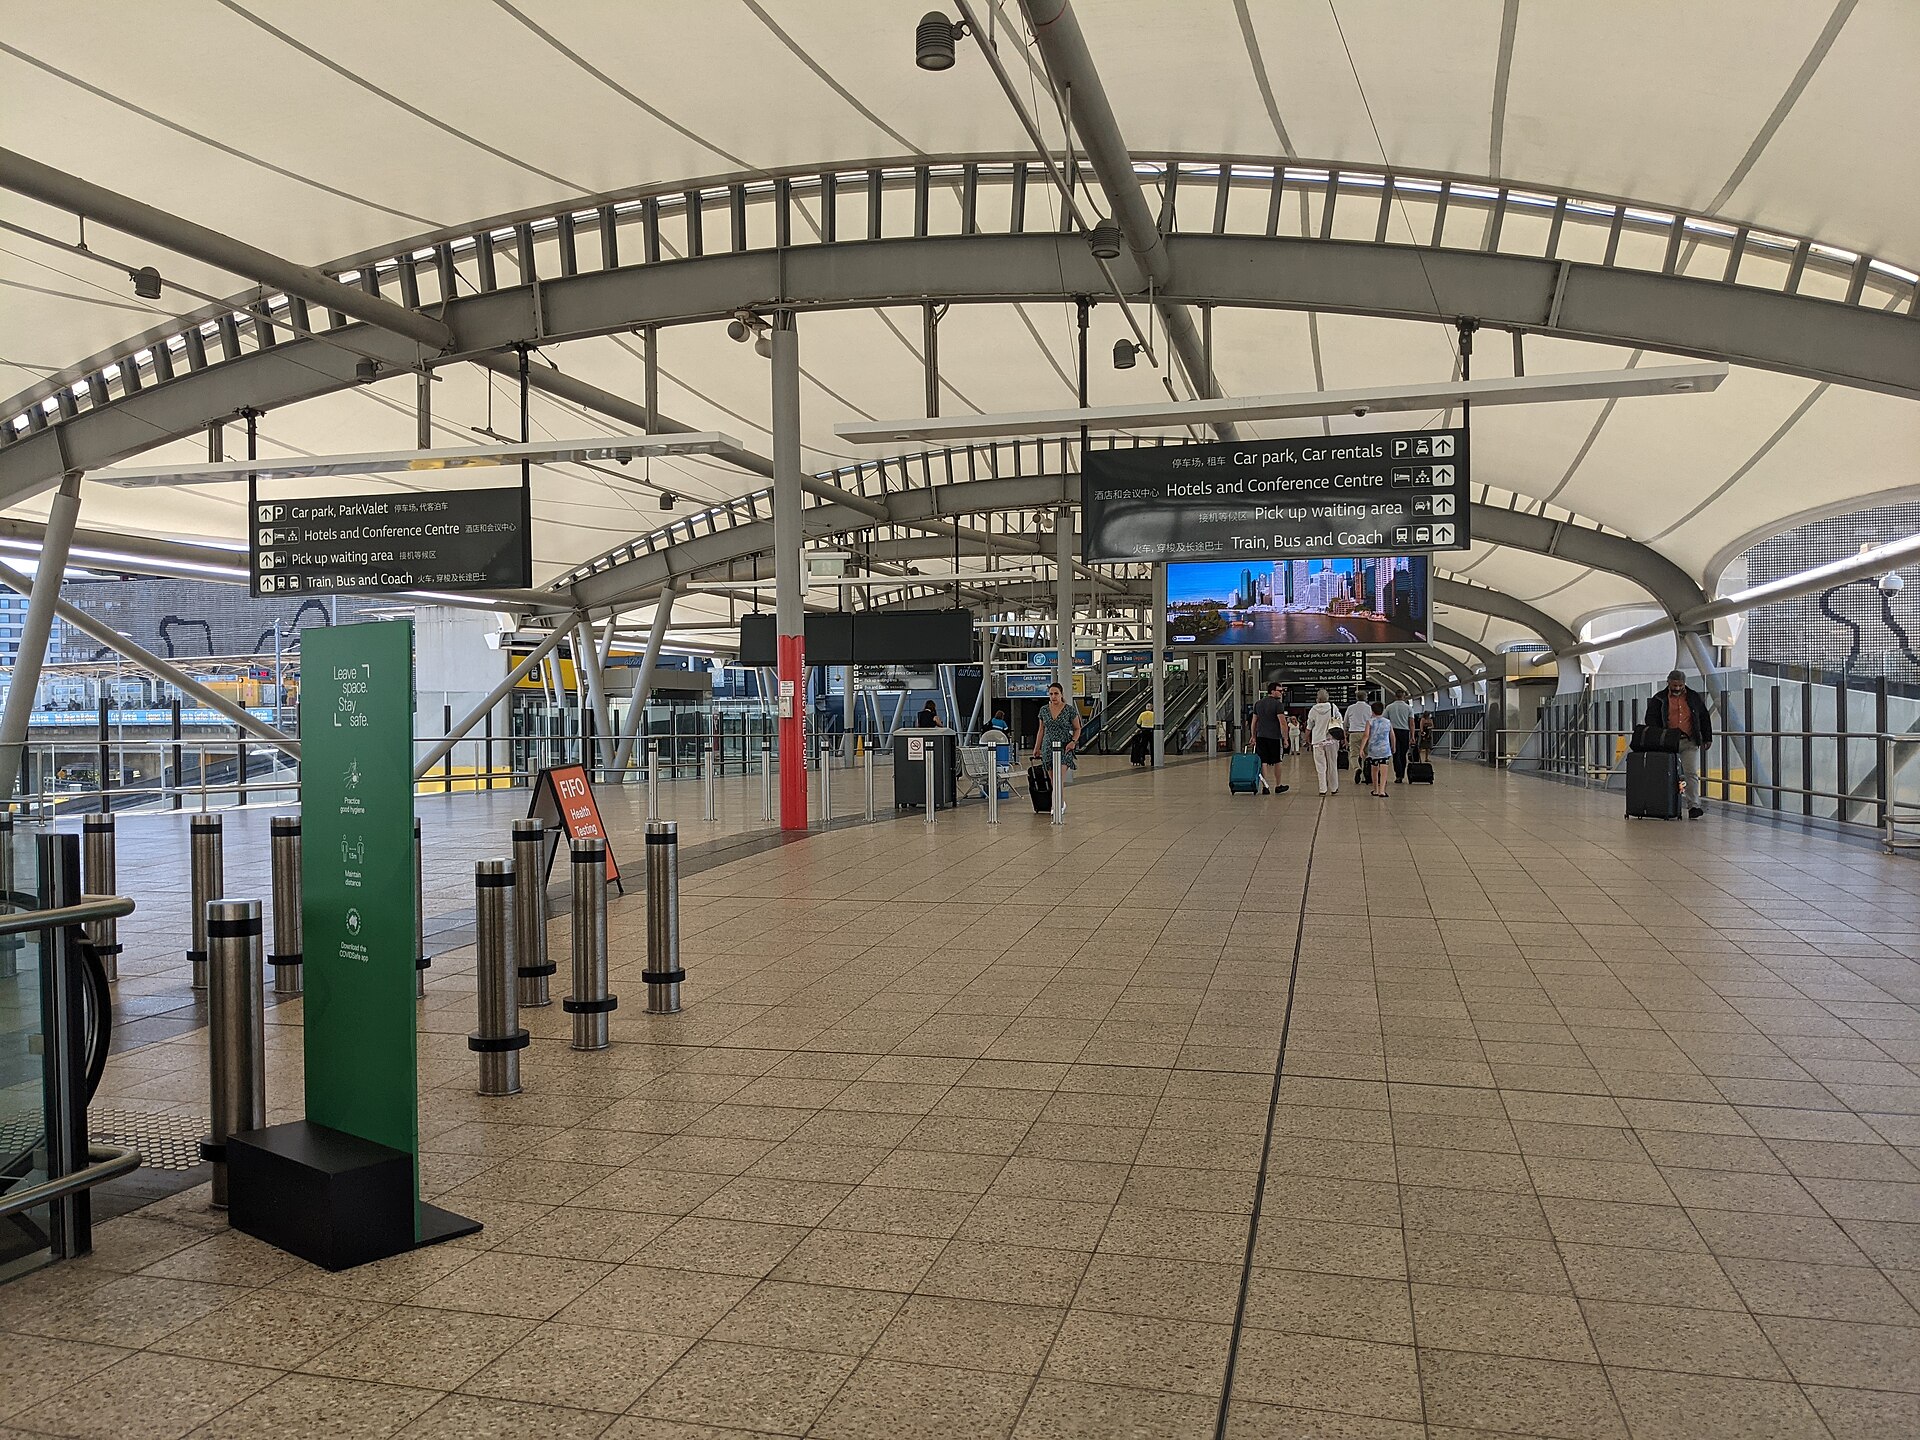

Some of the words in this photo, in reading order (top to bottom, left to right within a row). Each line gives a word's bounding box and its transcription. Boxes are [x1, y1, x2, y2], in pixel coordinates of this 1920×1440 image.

[1234, 452, 1258, 465] Car
[1262, 448, 1298, 467] park,
[1302, 448, 1327, 460] Car
[1332, 444, 1383, 459] rentals
[1167, 481, 1212, 497] Hotels
[1216, 478, 1243, 493] and
[1248, 476, 1329, 491] Conference
[1334, 474, 1383, 488] Centre
[292, 507, 308, 518] Car
[312, 505, 336, 520] park,
[339, 502, 388, 515] ParkValet
[1255, 506, 1284, 520] Pick
[1288, 508, 1306, 522] up
[1312, 504, 1366, 519] waiting
[1371, 503, 1403, 515] area
[304, 528, 337, 540] Hotels
[340, 526, 359, 539] and
[362, 525, 421, 538] Conference
[424, 524, 460, 536] Centre
[1231, 536, 1269, 550] Train,
[1274, 535, 1300, 548] Bus
[1305, 532, 1333, 547] and
[1338, 530, 1383, 545] Coach
[292, 553, 312, 565] Pick
[315, 555, 327, 566] up
[330, 551, 367, 565] waiting
[371, 551, 393, 562] area
[307, 576, 334, 588] Train,
[336, 576, 355, 587] Bus
[359, 573, 378, 586] and
[380, 572, 412, 584] Coach
[334, 666, 357, 680] Leave
[343, 682, 368, 697] space.
[339, 697, 356, 714] Stay
[350, 713, 368, 726] safe.
[560, 778, 584, 799] FIFO
[570, 806, 591, 820] Health
[575, 823, 598, 836] Testing
[345, 870, 361, 878] Maintain
[341, 942, 359, 951] Download
[339, 950, 360, 960] COVIDSafe
